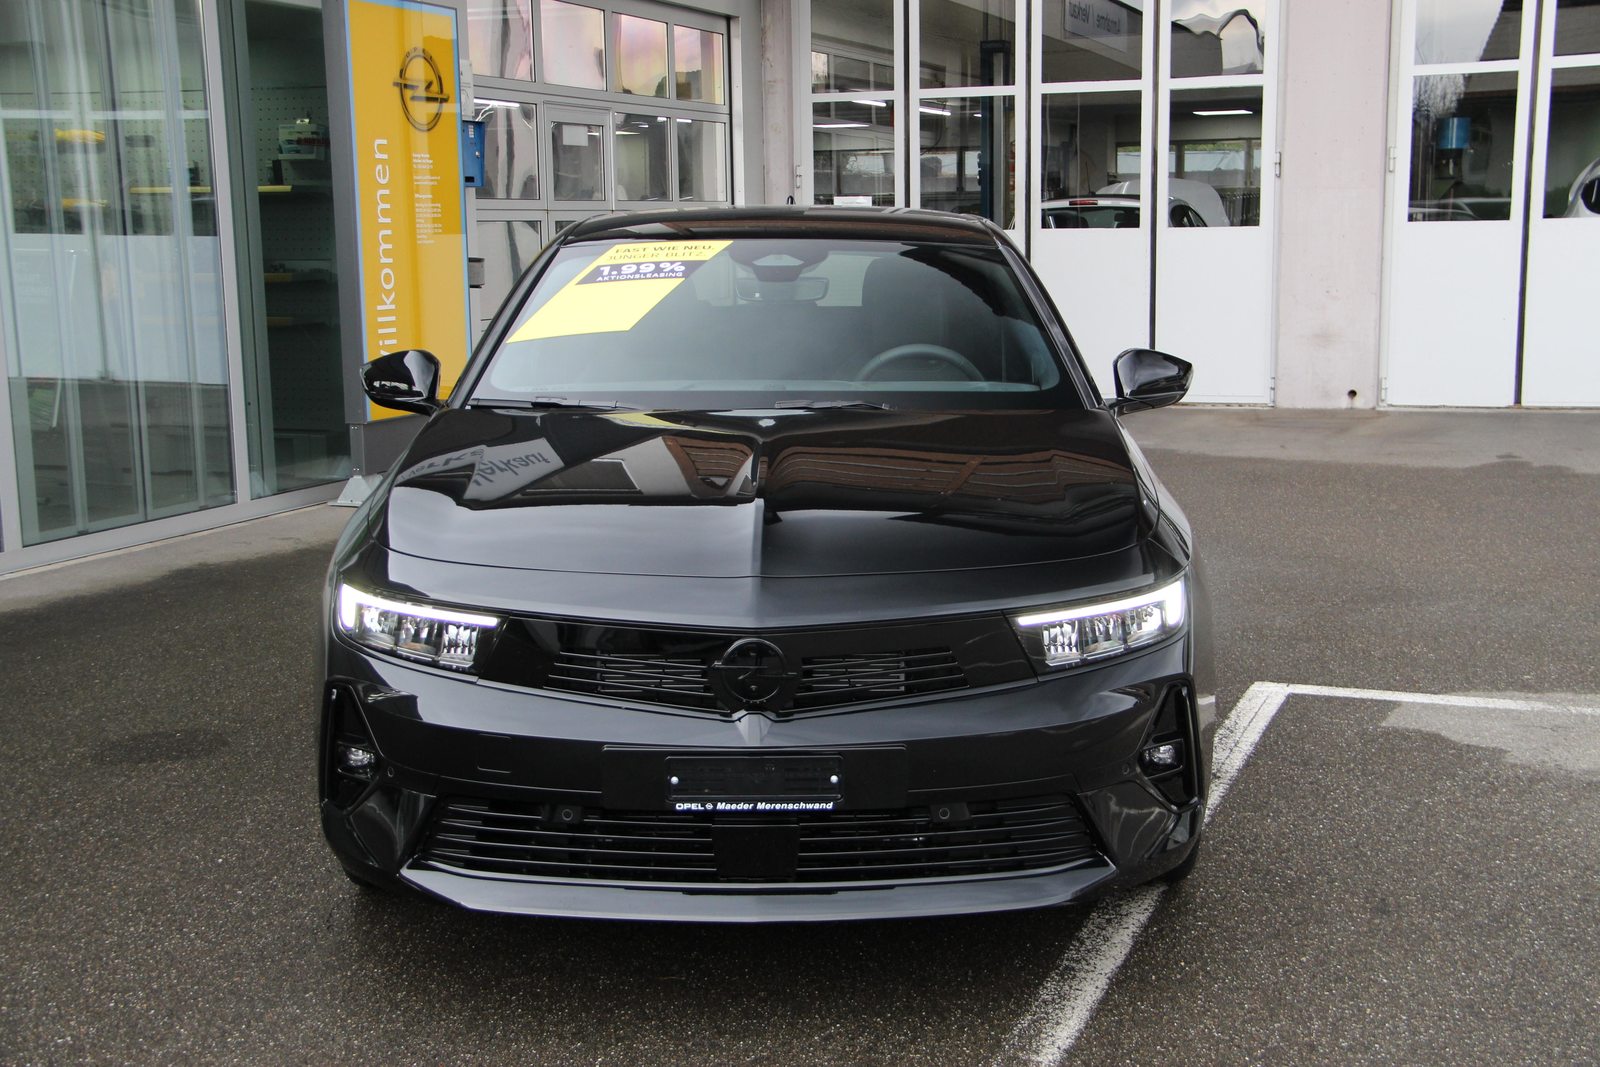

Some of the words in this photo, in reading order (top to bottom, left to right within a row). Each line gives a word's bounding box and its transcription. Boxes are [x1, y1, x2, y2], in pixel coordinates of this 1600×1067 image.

[374, 138, 398, 356] illkommen
[600, 262, 656, 276] 1.99
[660, 261, 686, 272] %
[596, 272, 683, 281] AKTIONSLEASING
[716, 801, 754, 810] Maeder
[756, 801, 833, 810] Merenschwand
